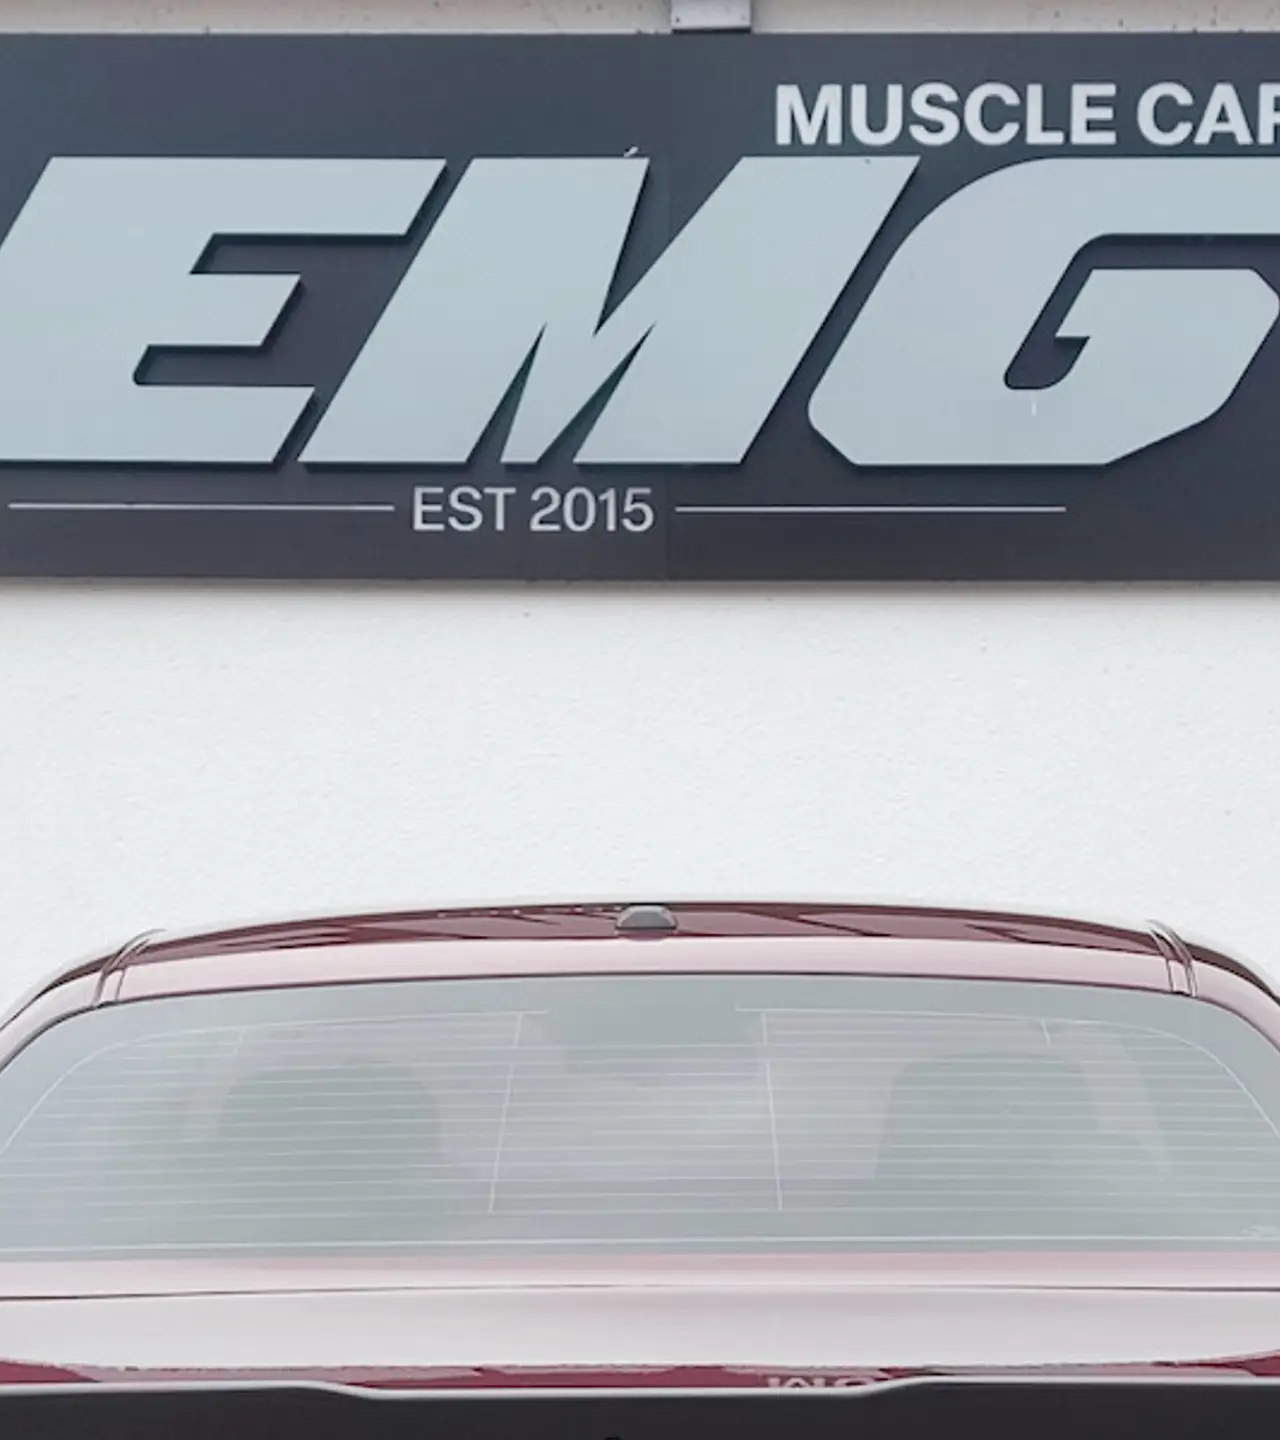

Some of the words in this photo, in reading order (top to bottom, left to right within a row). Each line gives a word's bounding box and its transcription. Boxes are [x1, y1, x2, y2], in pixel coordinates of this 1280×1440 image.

[774, 81, 1118, 146] MUSCLE
[412, 485, 518, 532] EST
[529, 485, 655, 532] 2015
